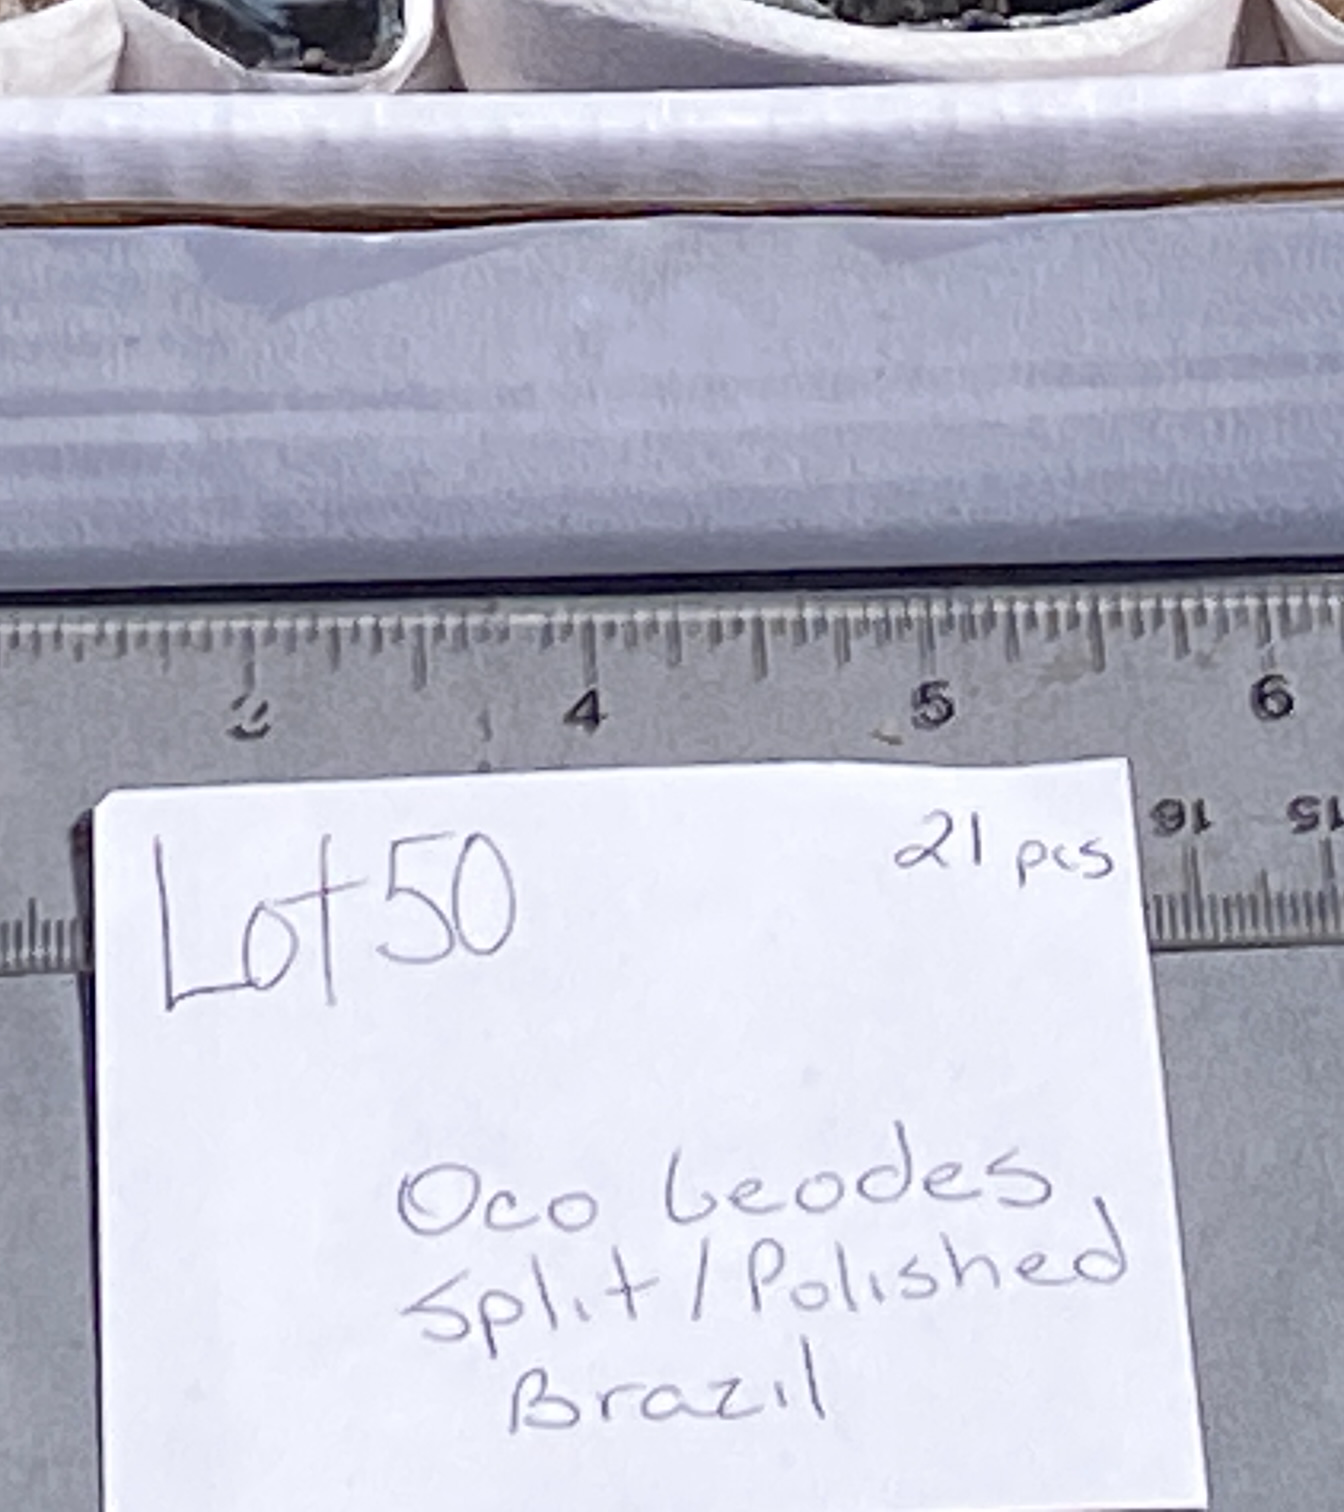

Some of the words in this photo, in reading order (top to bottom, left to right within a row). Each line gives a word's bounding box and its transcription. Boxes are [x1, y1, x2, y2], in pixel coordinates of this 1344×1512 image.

[562, 688, 609, 736] 4
[909, 679, 956, 731] 5
[1248, 673, 1296, 722] 6
[893, 809, 982, 869] 21
[1015, 836, 1114, 889] pcs
[1148, 796, 1213, 837] 16
[153, 833, 368, 1012] Lot
[375, 831, 517, 965] 50
[396, 1161, 599, 1236] Oco
[507, 1334, 827, 1435] Brazil
